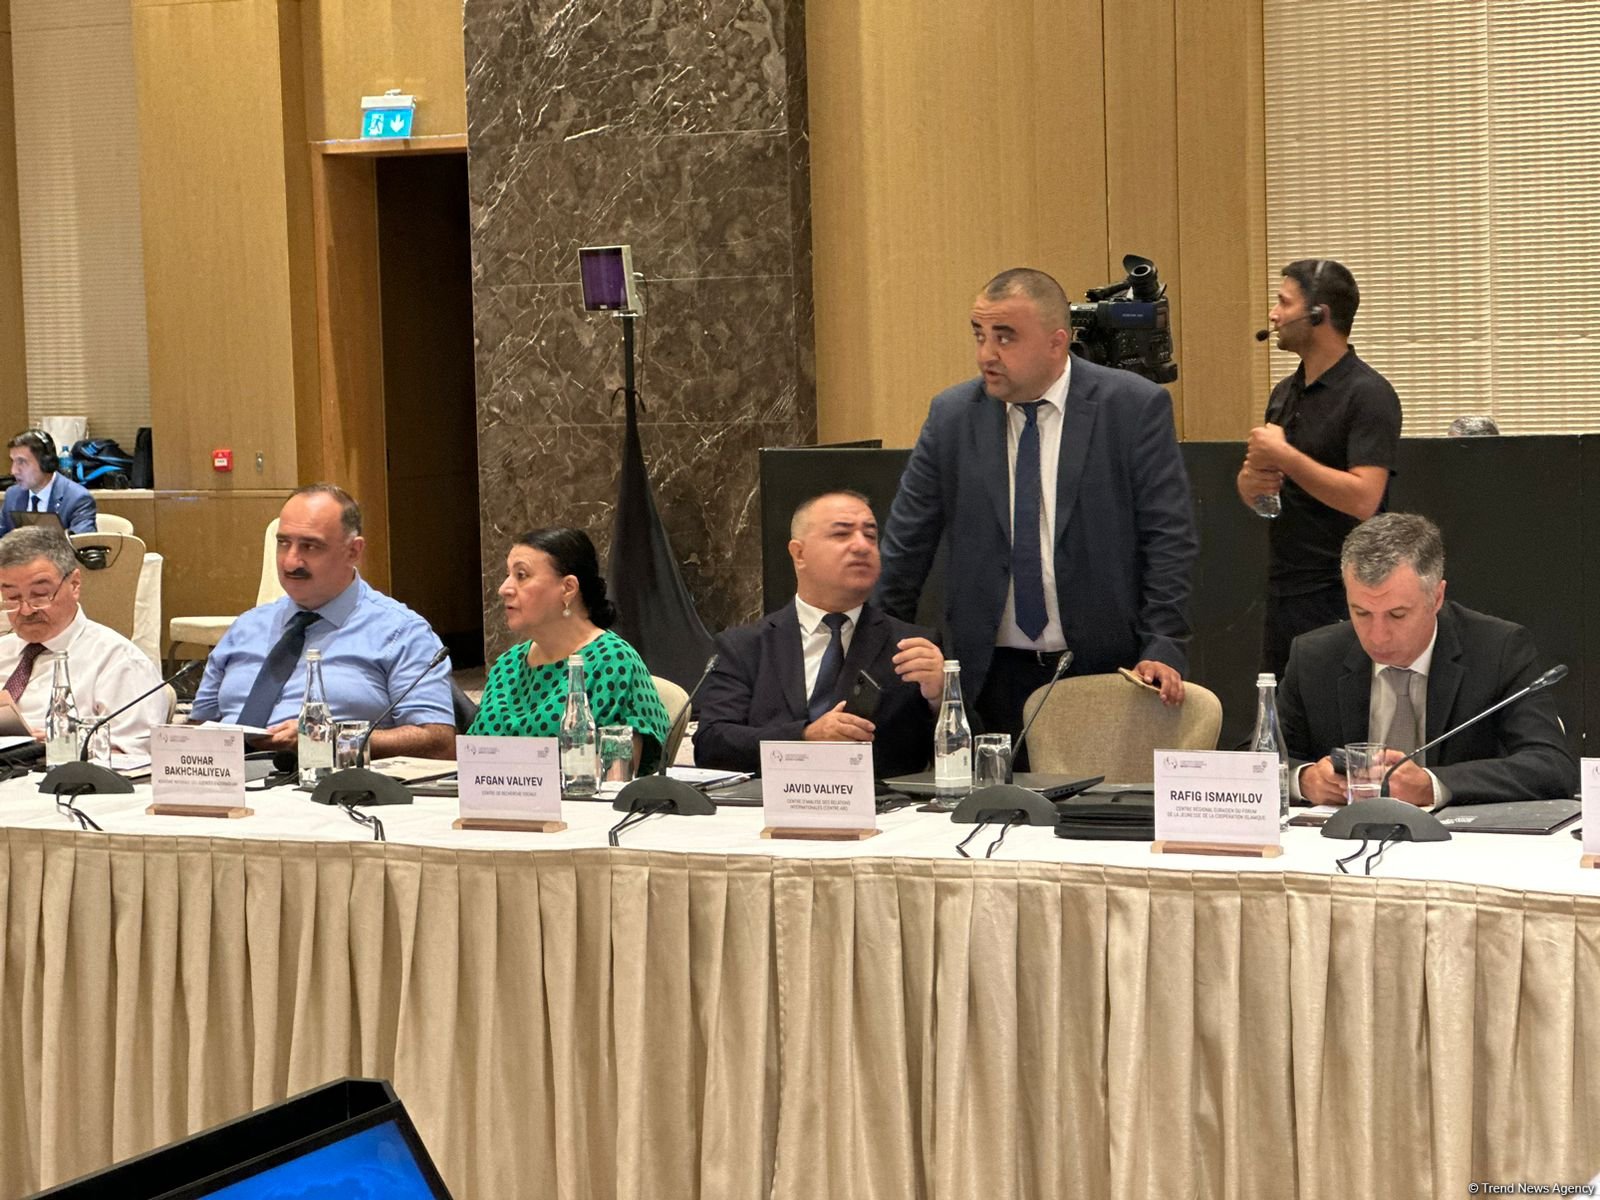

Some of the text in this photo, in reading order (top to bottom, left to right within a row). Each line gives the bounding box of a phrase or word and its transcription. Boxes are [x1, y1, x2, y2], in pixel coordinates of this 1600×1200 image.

[180, 755, 214, 766] GOVHAR
[164, 766, 231, 777] BAKHCHALIYEVA
[474, 775, 543, 786] AFGAN VALIYEV
[783, 783, 853, 795] JAVID VALIYEV
[1170, 790, 1263, 804] RAFIG ISMAYILOV
